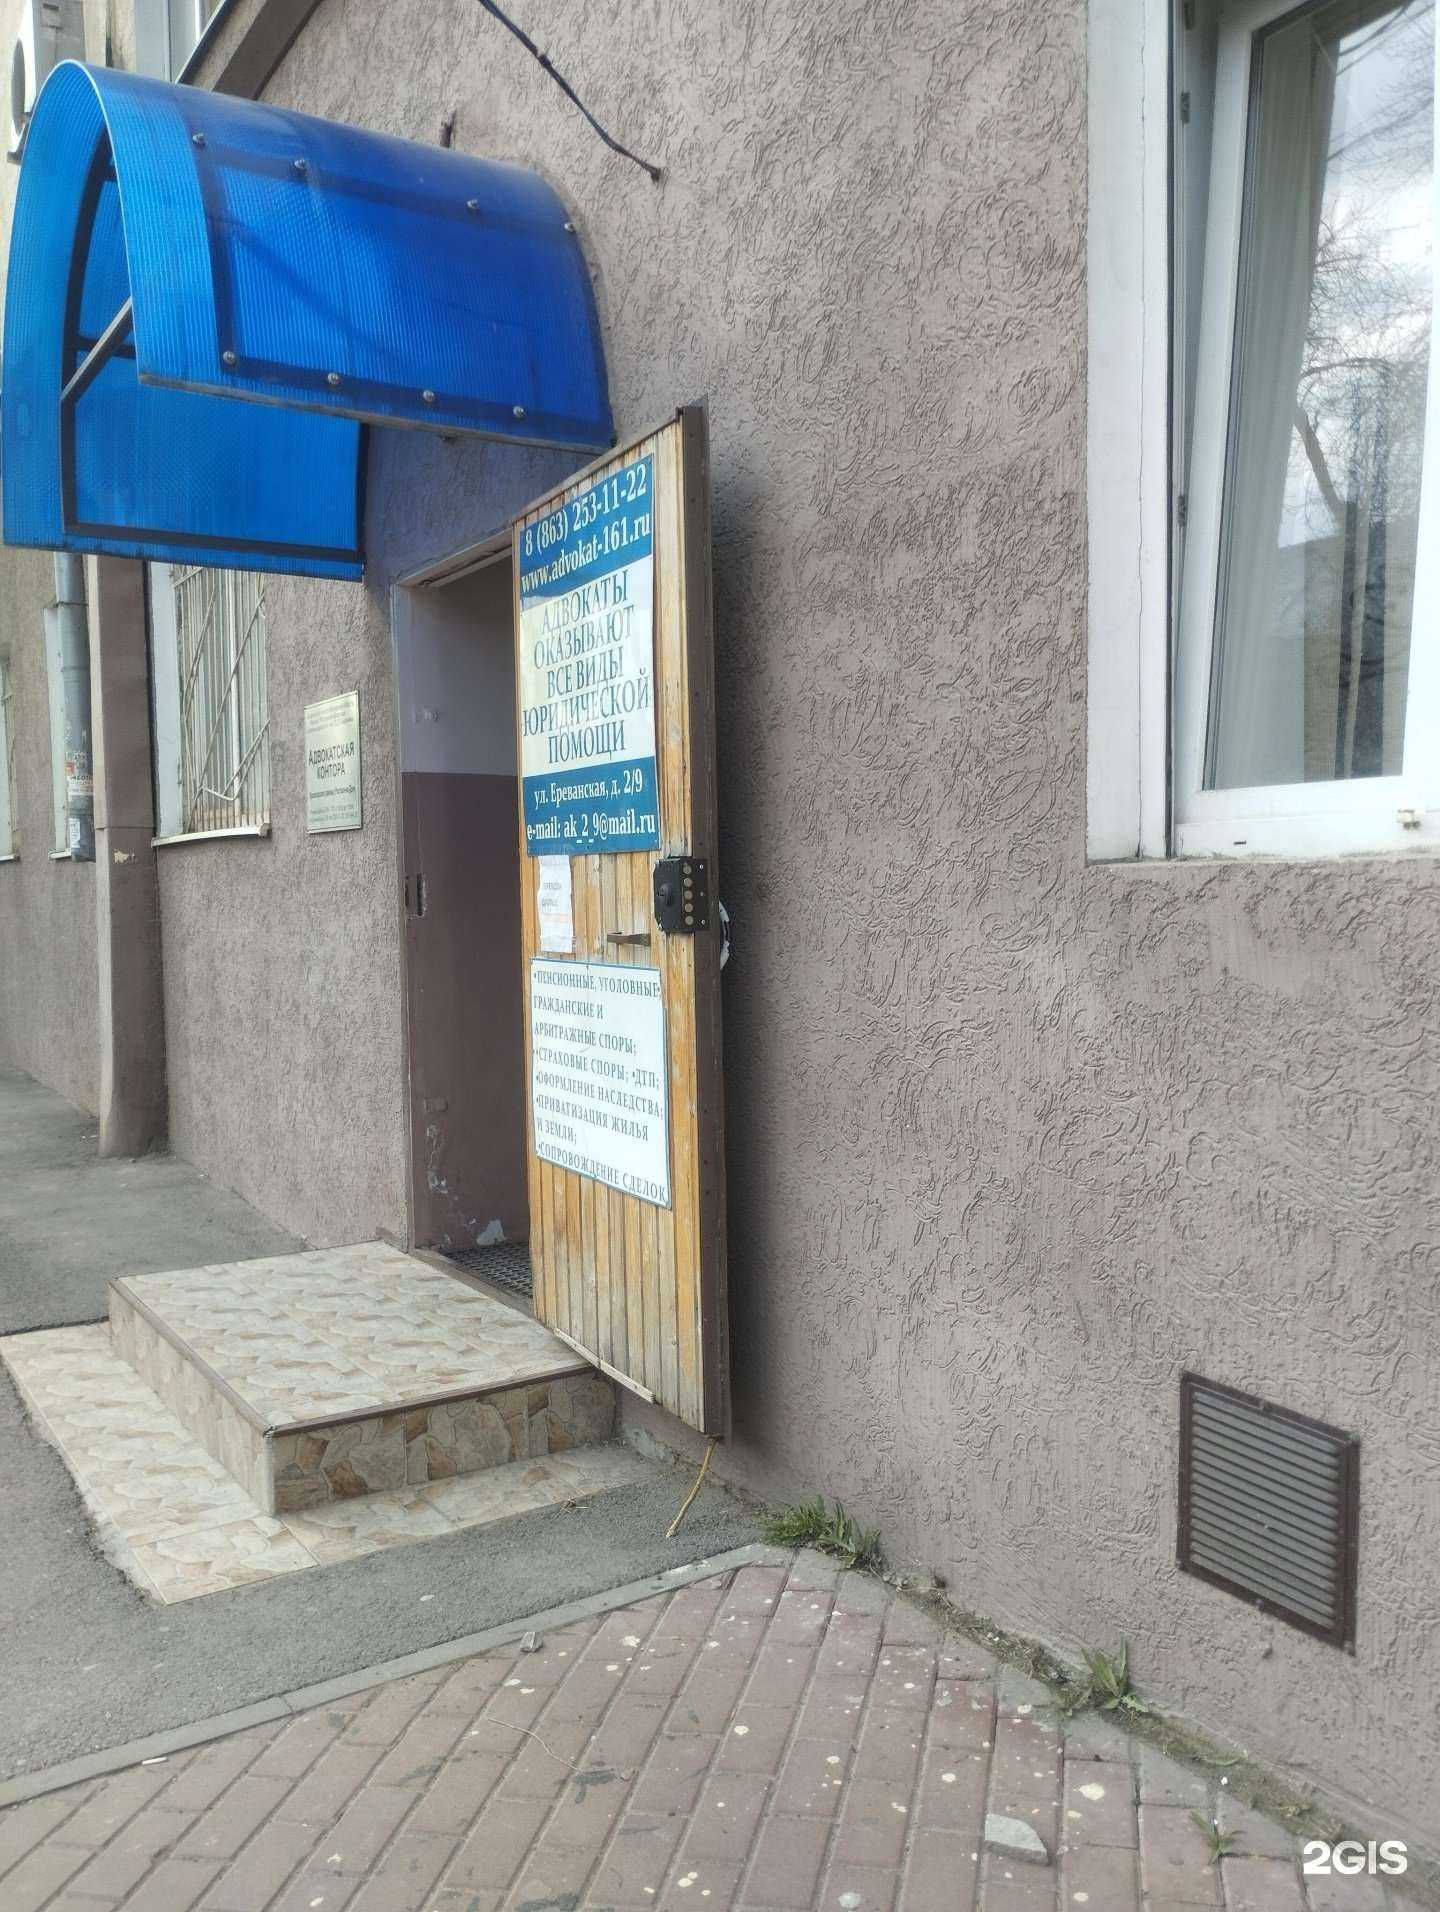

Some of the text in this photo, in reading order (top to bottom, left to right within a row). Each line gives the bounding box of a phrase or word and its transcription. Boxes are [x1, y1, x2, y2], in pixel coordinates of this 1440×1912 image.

[525, 463, 647, 556] 8 (863) 253-11-22
[521, 512, 651, 593] www.advokat-161.ru
[542, 570, 630, 635] АДВОКАТЫ
[534, 605, 635, 670] ОКАЗЫВАЮТ
[546, 646, 625, 699] ВСЕ ВИДЫ
[523, 667, 651, 737] ЮРИДИЧЕСКОЙ
[309, 742, 355, 765] АДВОКАТСКАЯ
[548, 719, 627, 764] ПОМОЩИ
[316, 761, 346, 780] КОНТОРА
[534, 768, 643, 810] ул. Ереванская, д. 2/9
[527, 814, 561, 840] e-mail:
[533, 995, 604, 1020] ГРАЖДАНСКИЕ И
[534, 1022, 597, 1046] АРБИТРАЖНЫЕ
[536, 1116, 544, 1132] И
[611, 1115, 649, 1142] ЖИЛЬЯ
